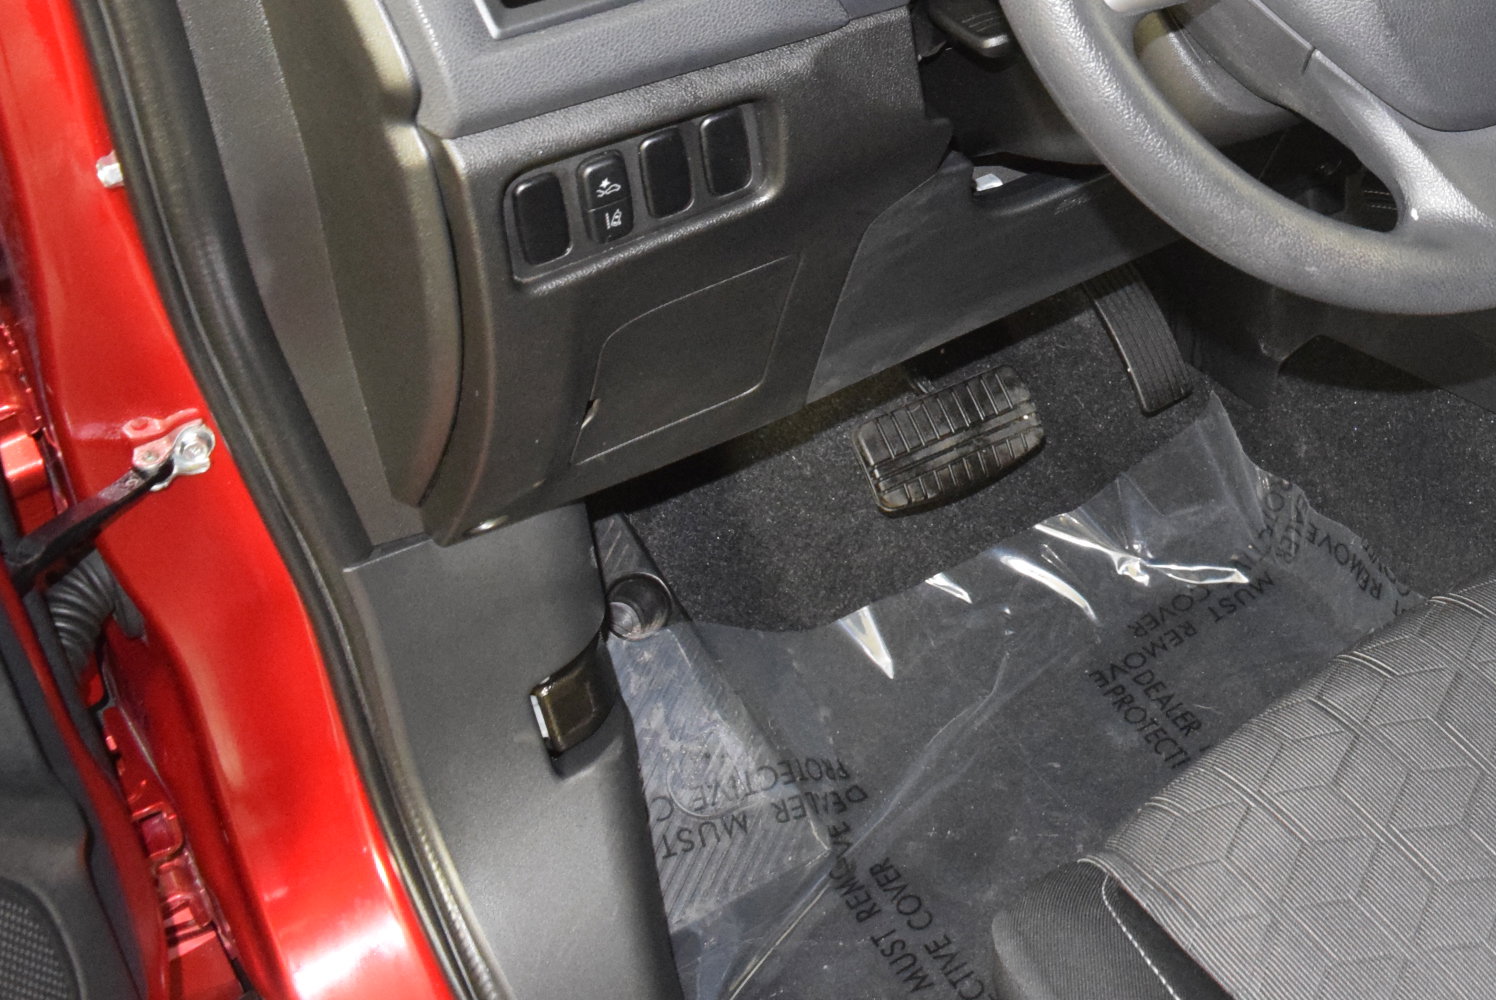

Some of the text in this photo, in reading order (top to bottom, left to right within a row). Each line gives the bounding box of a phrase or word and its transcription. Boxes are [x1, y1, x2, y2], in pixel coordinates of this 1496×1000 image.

[1207, 570, 1275, 624] MUST
[1307, 526, 1383, 600] REMOVE
[1127, 586, 1211, 640] COVER
[1089, 622, 1198, 690] REMOVE
[1133, 669, 1203, 737] DEALER
[693, 757, 850, 812] PROTECTIVE
[661, 783, 869, 860] DEALER MUST
[828, 821, 935, 994] MUST REMOVE
[868, 857, 996, 1000] CTIVE COVER
